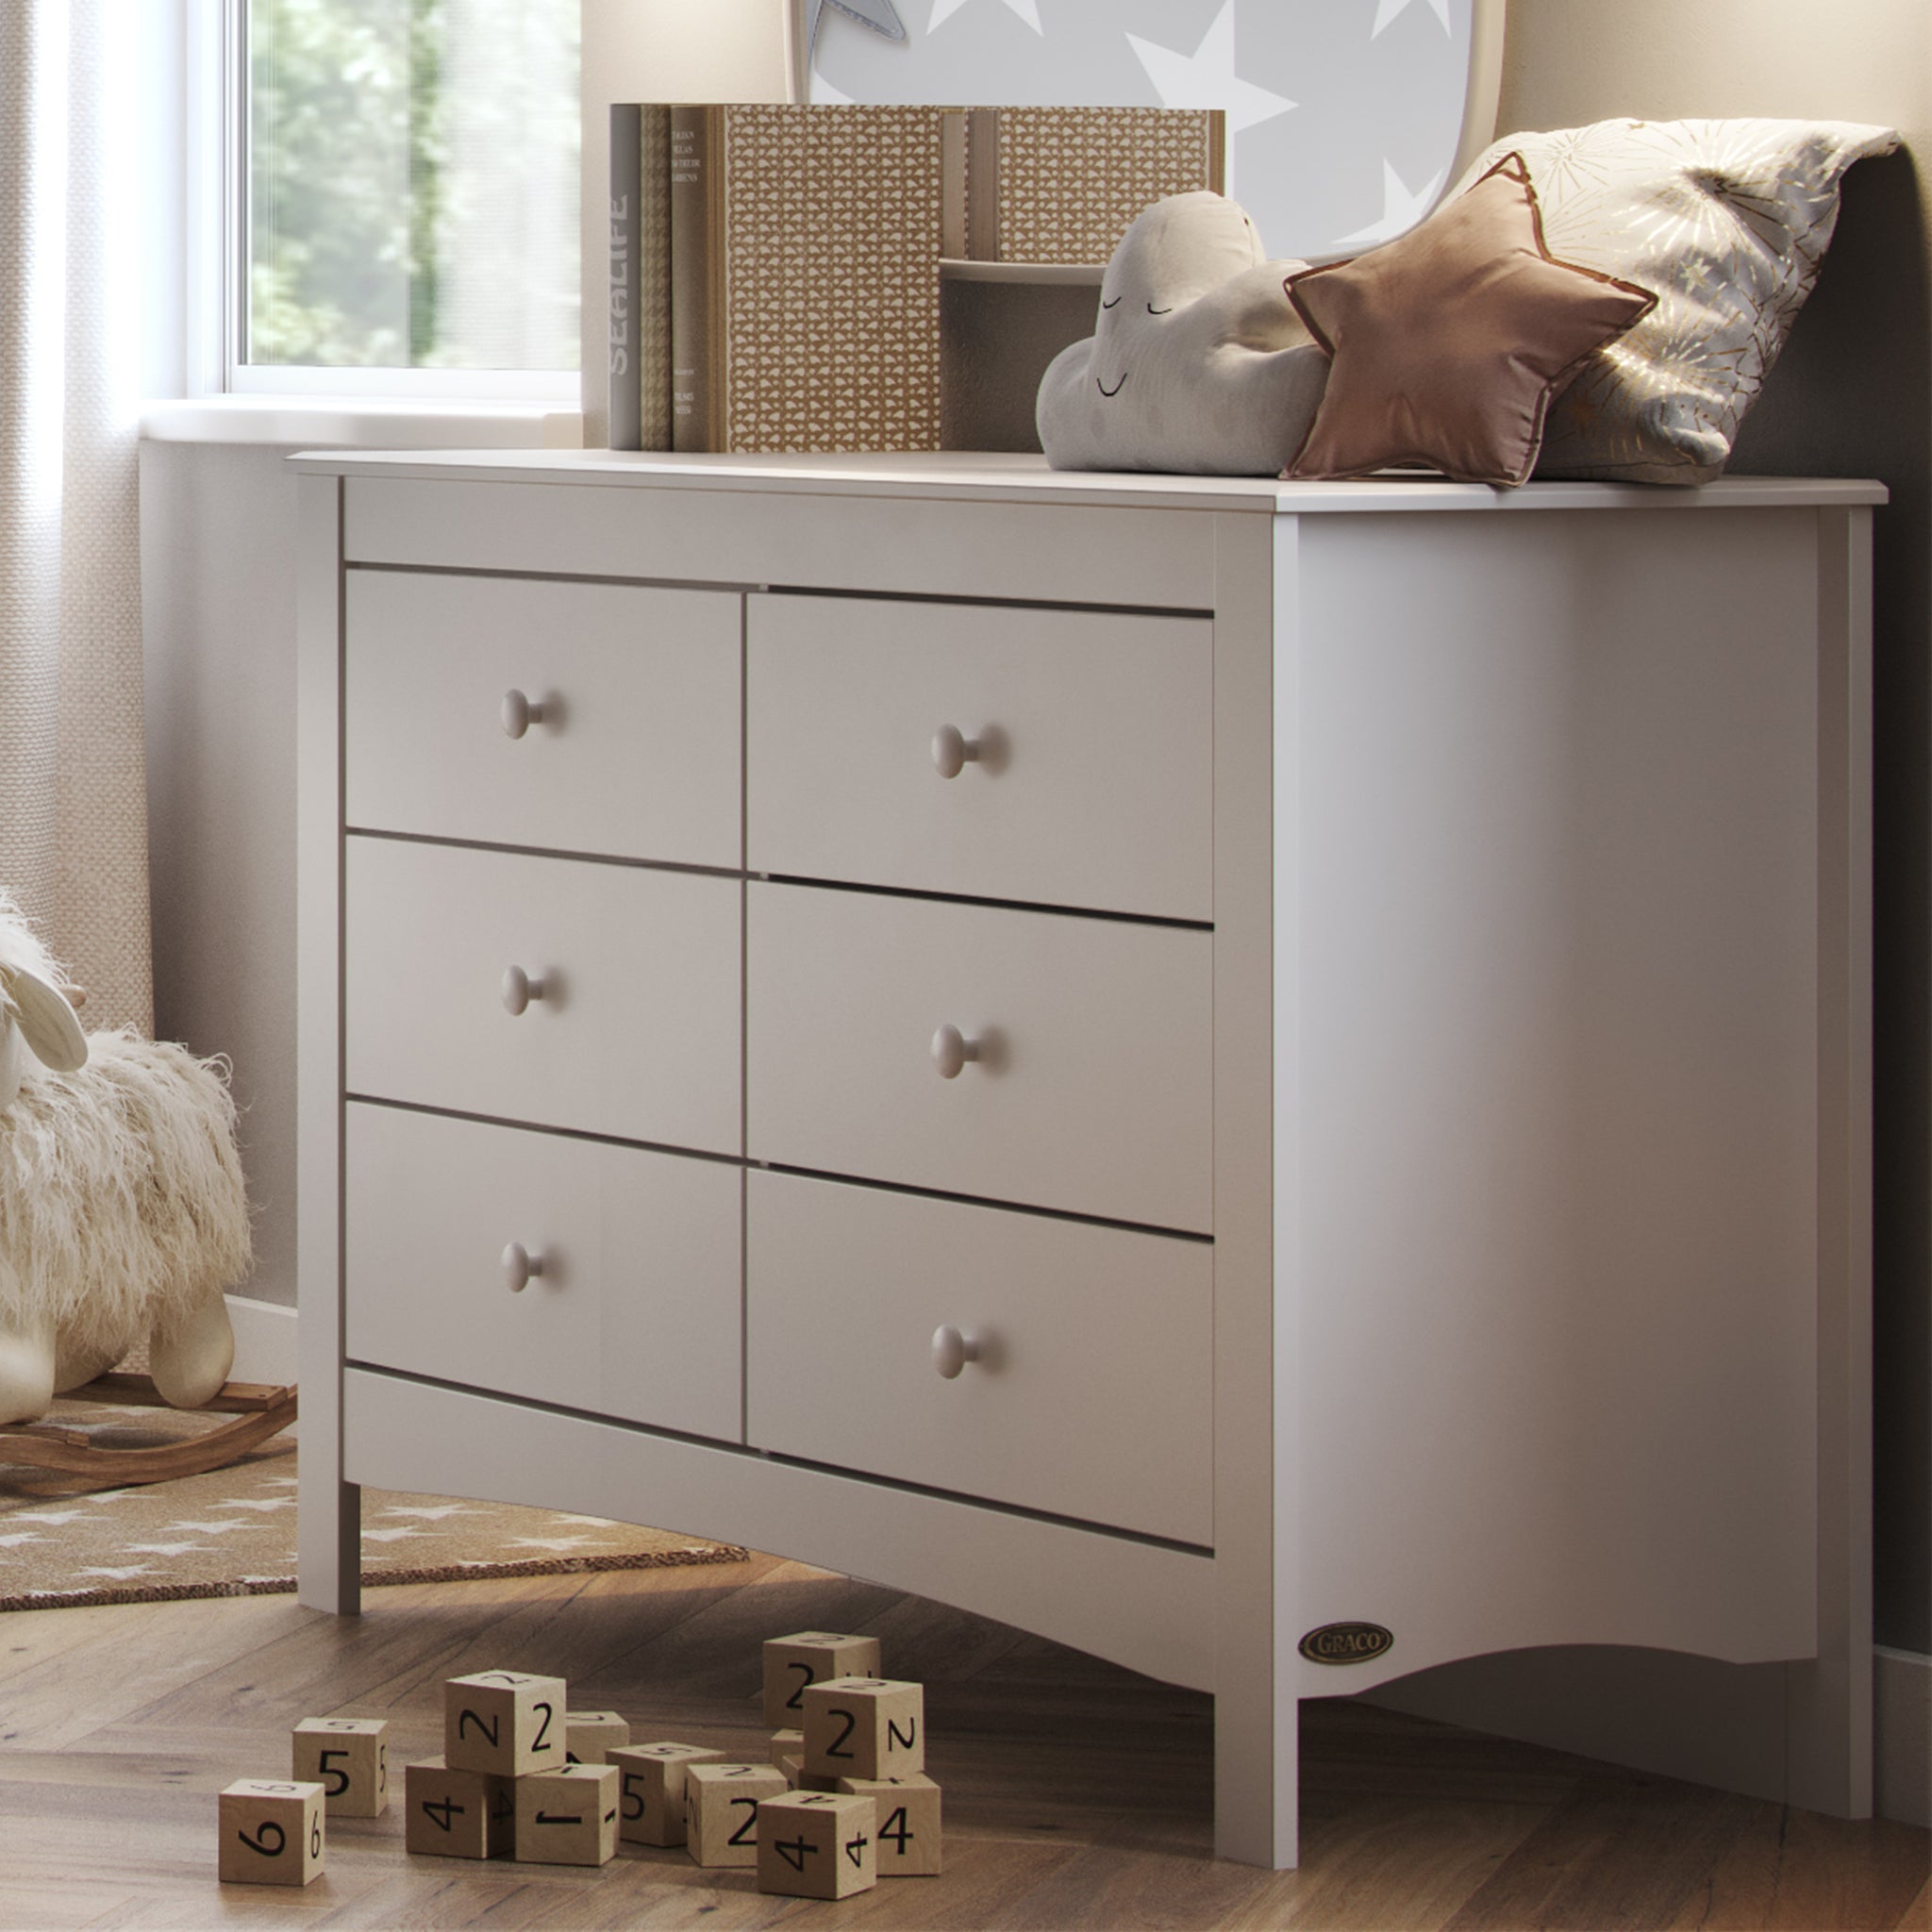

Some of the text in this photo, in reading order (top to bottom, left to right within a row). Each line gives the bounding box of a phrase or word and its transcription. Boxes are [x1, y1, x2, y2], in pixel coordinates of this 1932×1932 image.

[1318, 1632, 1381, 1654] GRACO
[786, 1662, 814, 1709] 2
[458, 1708, 499, 1748] 2
[531, 1702, 553, 1752] 2
[826, 1709, 856, 1758] 2
[319, 1750, 349, 1797] 5
[422, 1796, 464, 1832] 4
[622, 1773, 644, 1822] 5
[238, 1821, 286, 1857] 6
[310, 1809, 321, 1859] 6
[728, 1797, 758, 1846] 2
[877, 1807, 914, 1856] 4
[774, 1834, 818, 1874] 4
[846, 1831, 868, 1869] 4
